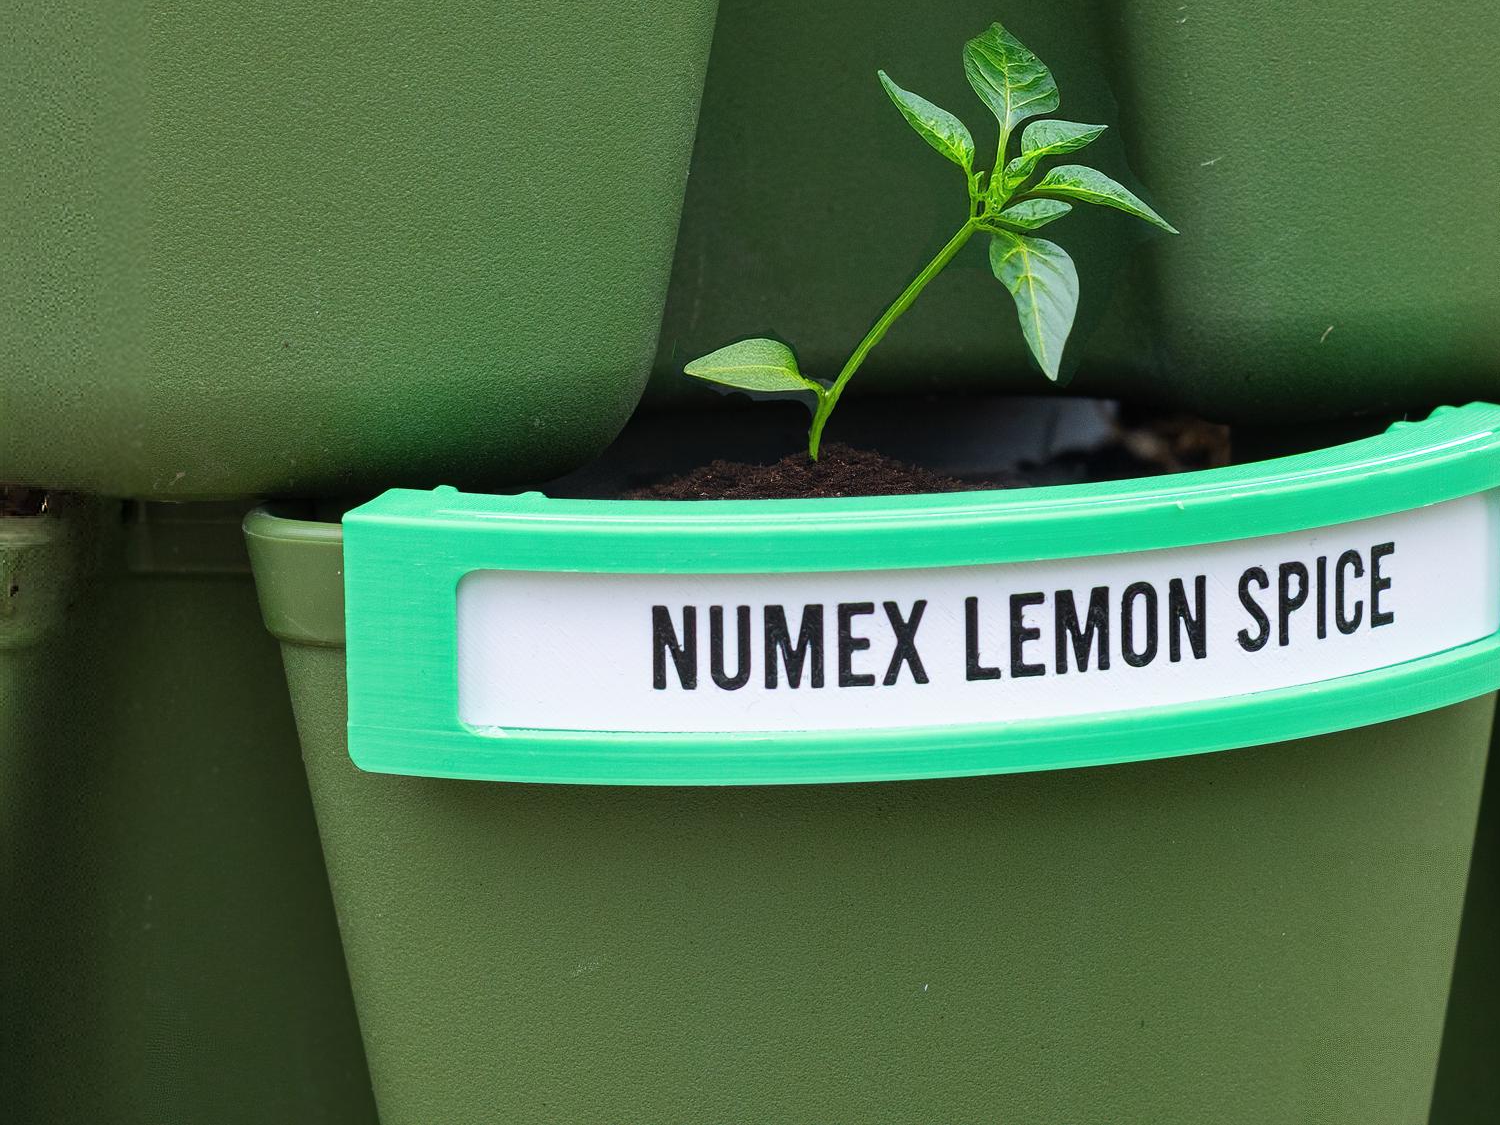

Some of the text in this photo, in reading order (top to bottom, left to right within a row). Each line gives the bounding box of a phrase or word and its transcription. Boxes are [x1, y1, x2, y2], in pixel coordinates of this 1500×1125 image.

[650, 541, 1396, 691] NUMEX LEMON SPICE
